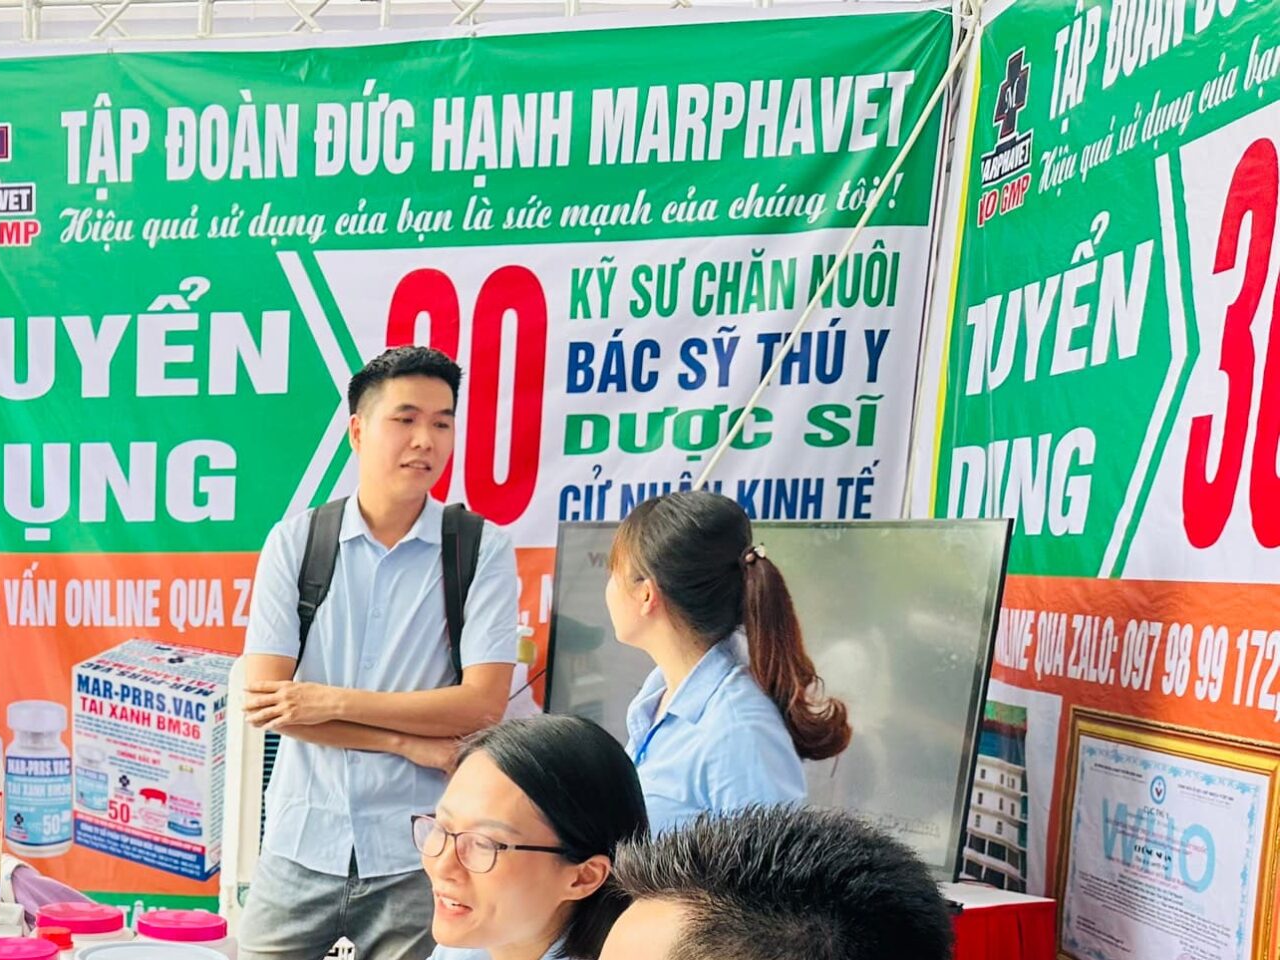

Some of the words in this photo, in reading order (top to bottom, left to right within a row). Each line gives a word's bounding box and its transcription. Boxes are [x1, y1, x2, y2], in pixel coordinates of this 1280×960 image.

[1049, 0, 1102, 134] TẬP
[1141, 89, 1195, 150] dụng
[1198, 52, 1239, 114] của
[60, 92, 150, 202] TẬP
[164, 84, 300, 181] ĐOÀN
[313, 78, 416, 177] ĐỨC
[431, 90, 573, 189] HẠNH
[589, 69, 916, 166] MARPHAVET
[59, 206, 135, 252] Hiệu
[142, 203, 200, 249] quả
[207, 202, 244, 238] sử
[248, 203, 327, 246] dụng
[334, 198, 389, 237] của
[396, 200, 453, 242] bạn
[464, 198, 493, 232] là
[503, 194, 553, 231] sức
[560, 189, 653, 237] mạnh
[661, 185, 721, 224] của
[727, 182, 830, 223] chúng
[568, 256, 618, 320] KỸ
[629, 257, 687, 318] SƯ
[691, 247, 797, 318] CHĂN
[807, 239, 901, 311] NUÔI
[965, 211, 1155, 397] TUYỂN
[565, 327, 662, 395] BÁC
[677, 325, 740, 390] SỸ
[756, 316, 848, 386] THÚ
[862, 327, 890, 384] Y
[563, 402, 773, 462] DƯỢC
[804, 394, 884, 449] SĨ
[559, 464, 612, 521] CỬ
[737, 477, 828, 521] KINH
[836, 460, 881, 520] TẾ
[4, 561, 57, 626] VẤN
[65, 579, 161, 627] ONLINE
[170, 579, 224, 632] QUA
[1035, 609, 1068, 680] QUA
[1067, 615, 1119, 687] ZALO:
[1122, 618, 1162, 693] 097
[1161, 622, 1191, 698] 98
[1194, 626, 1228, 703] 99
[77, 673, 206, 723] MAR-PRRS.VAC
[80, 696, 104, 715] TAI
[109, 703, 151, 728] XANH
[156, 716, 201, 741] BM36
[43, 814, 60, 836] 50
[108, 800, 131, 824] 50
